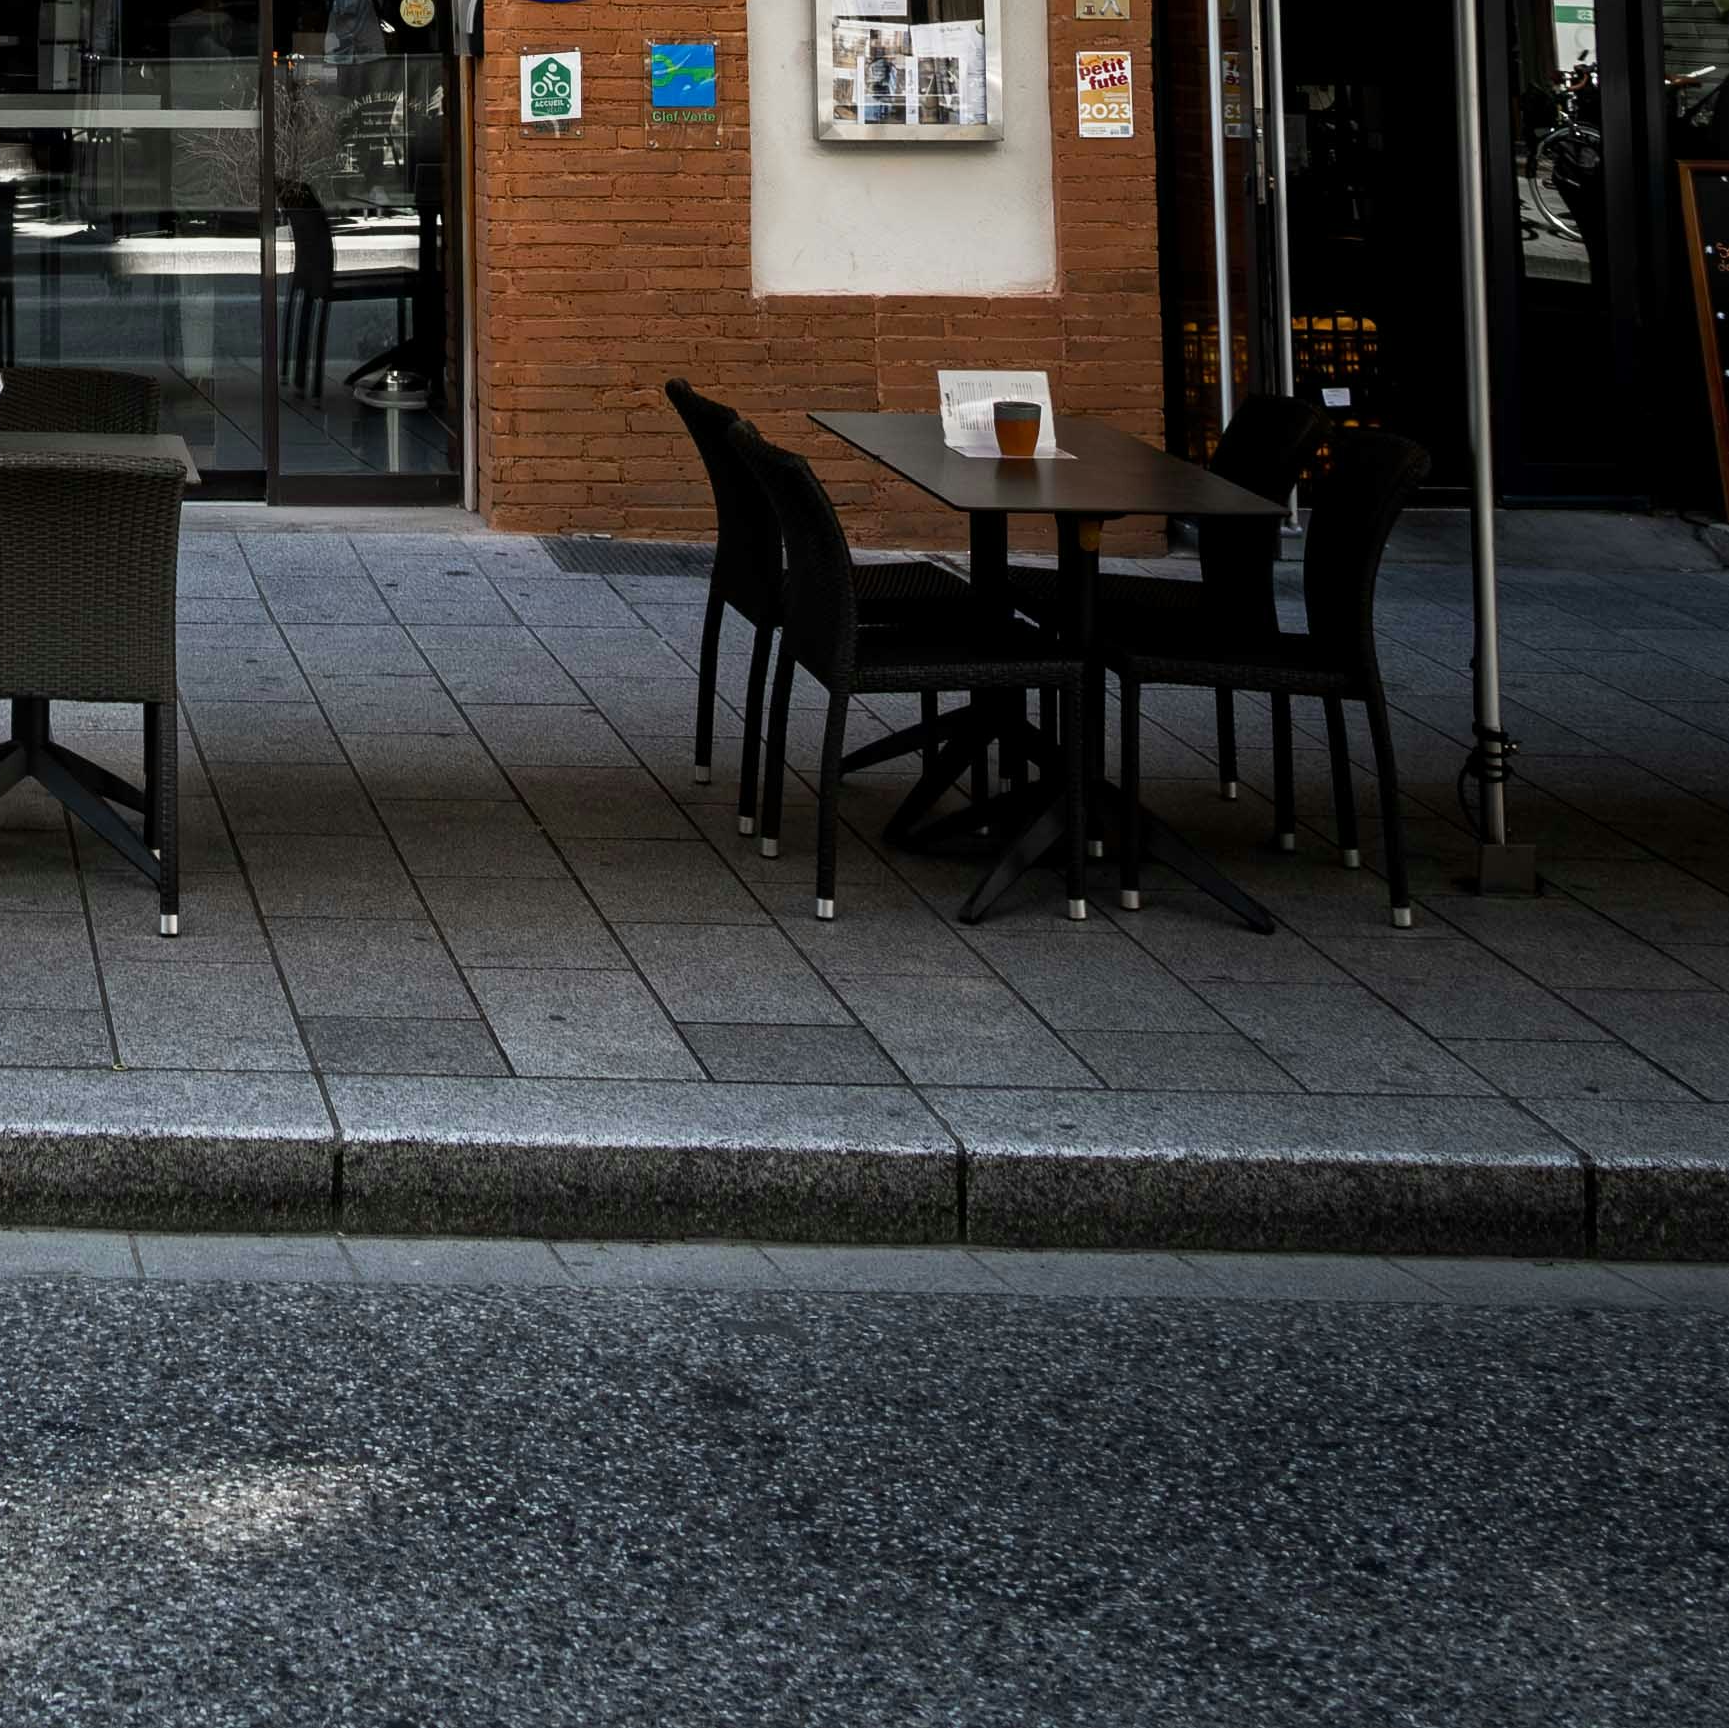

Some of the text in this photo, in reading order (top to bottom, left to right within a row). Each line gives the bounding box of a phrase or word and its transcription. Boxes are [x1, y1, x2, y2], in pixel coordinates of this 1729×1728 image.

[1079, 58, 1126, 81] petit
[1088, 71, 1129, 90] futé
[534, 99, 565, 108] ACCUEIL
[1079, 103, 1131, 120] 2023
[652, 110, 716, 122] Clef Verte
